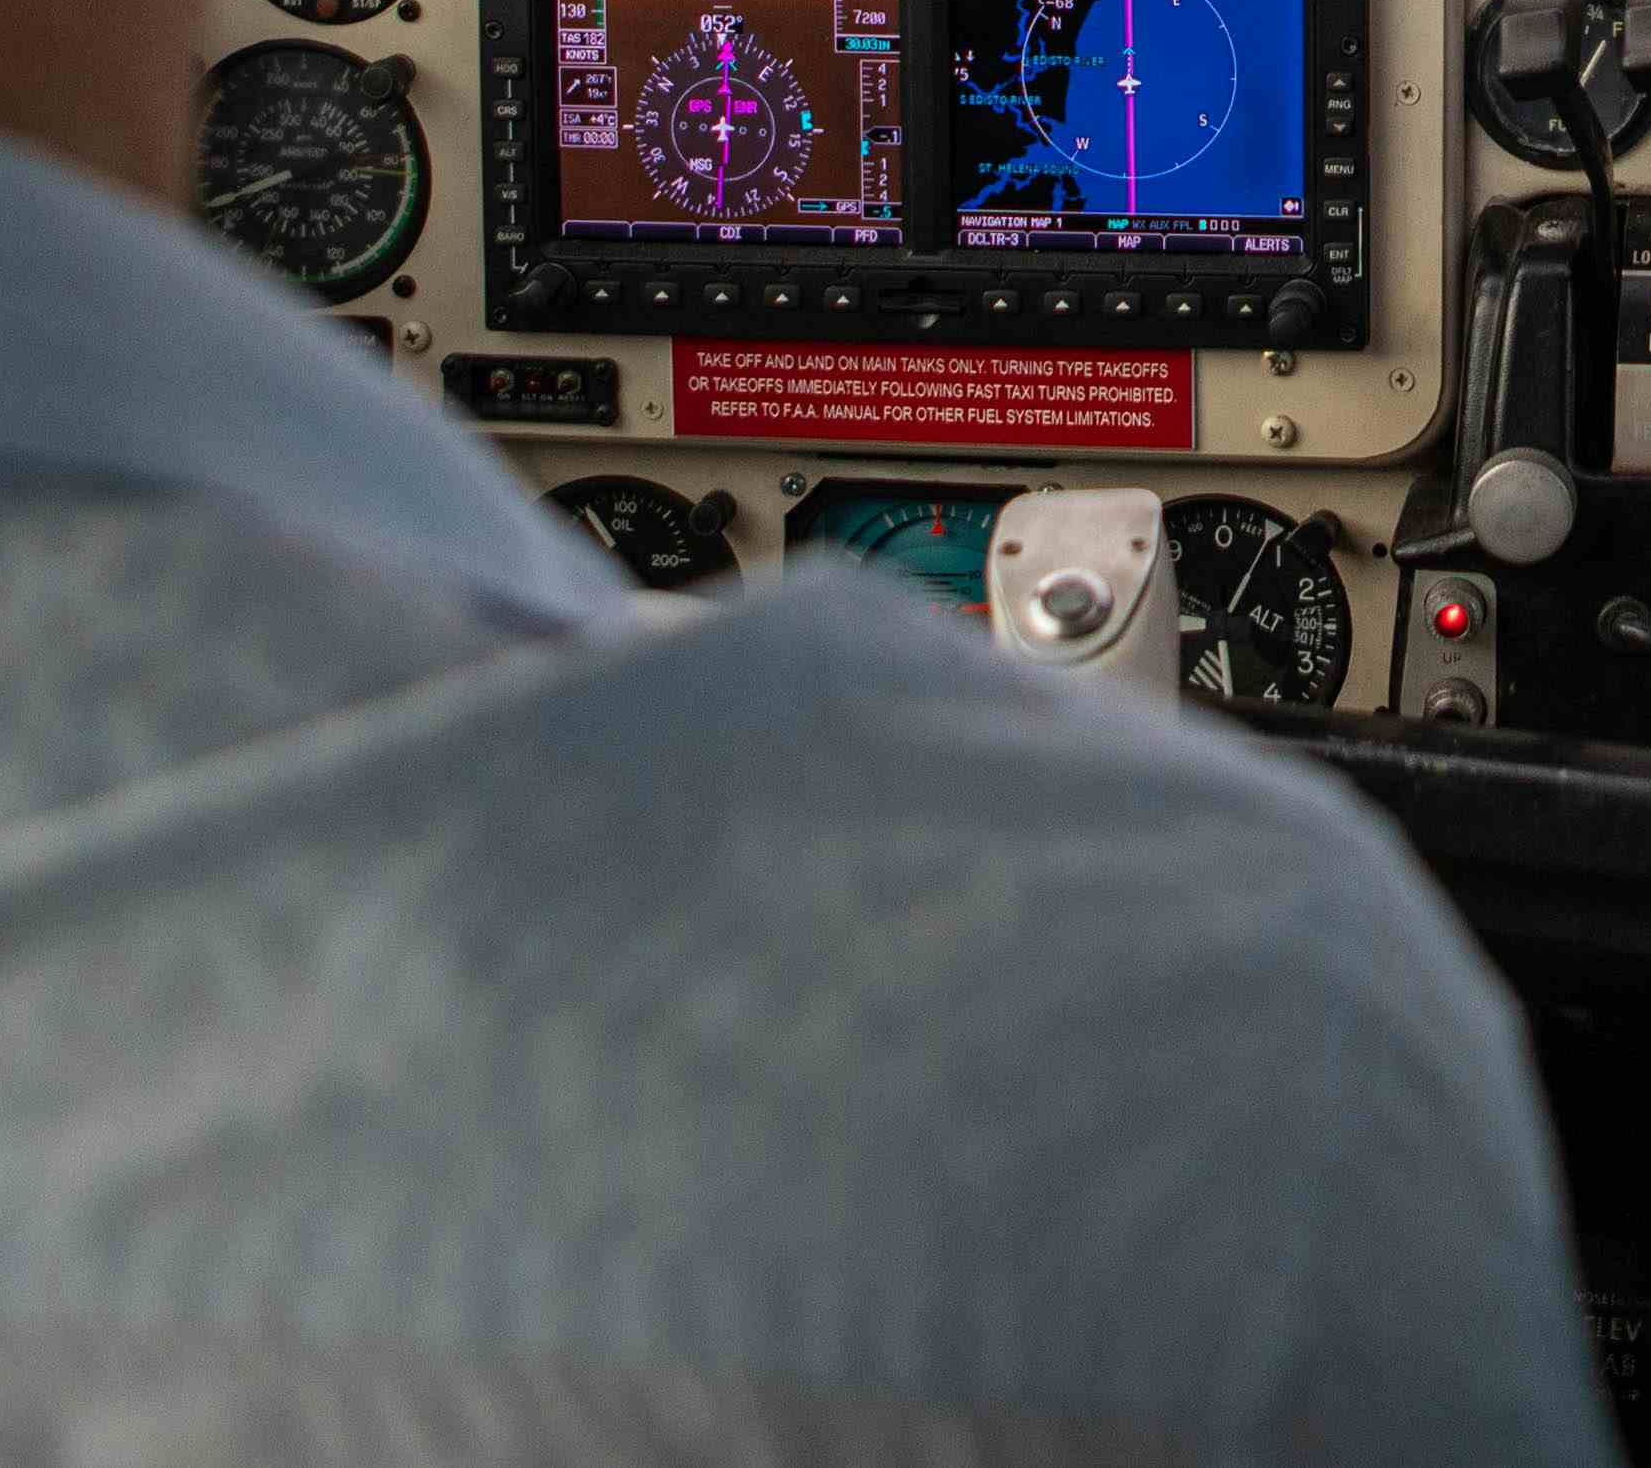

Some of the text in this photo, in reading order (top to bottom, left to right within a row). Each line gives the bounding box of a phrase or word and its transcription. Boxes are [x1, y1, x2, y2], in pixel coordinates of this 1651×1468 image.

[968, 233, 1019, 245] DCLTR-3
[1245, 240, 1289, 251] ALERTS
[698, 352, 1168, 378] TAKE OFF AND LAND ON MAIN TANKS ONLY. TURNING TYPE TAKEOFFS
[688, 376, 1176, 403] OR TAKEOFFS IMMEDIATELY FOLLOWING FAST TAXI TURNS PROHIBITED.
[711, 401, 757, 416] REFER
[762, 402, 780, 417] TO
[824, 405, 880, 420] MANUAL
[884, 406, 912, 421] FOR
[916, 407, 964, 422] OTHER
[968, 408, 1003, 424] FUEL
[1007, 409, 1063, 425] SYSTEM
[1067, 411, 1155, 427] LIMITATIONS.
[612, 520, 633, 531] OIL
[1250, 605, 1284, 632] ALT
